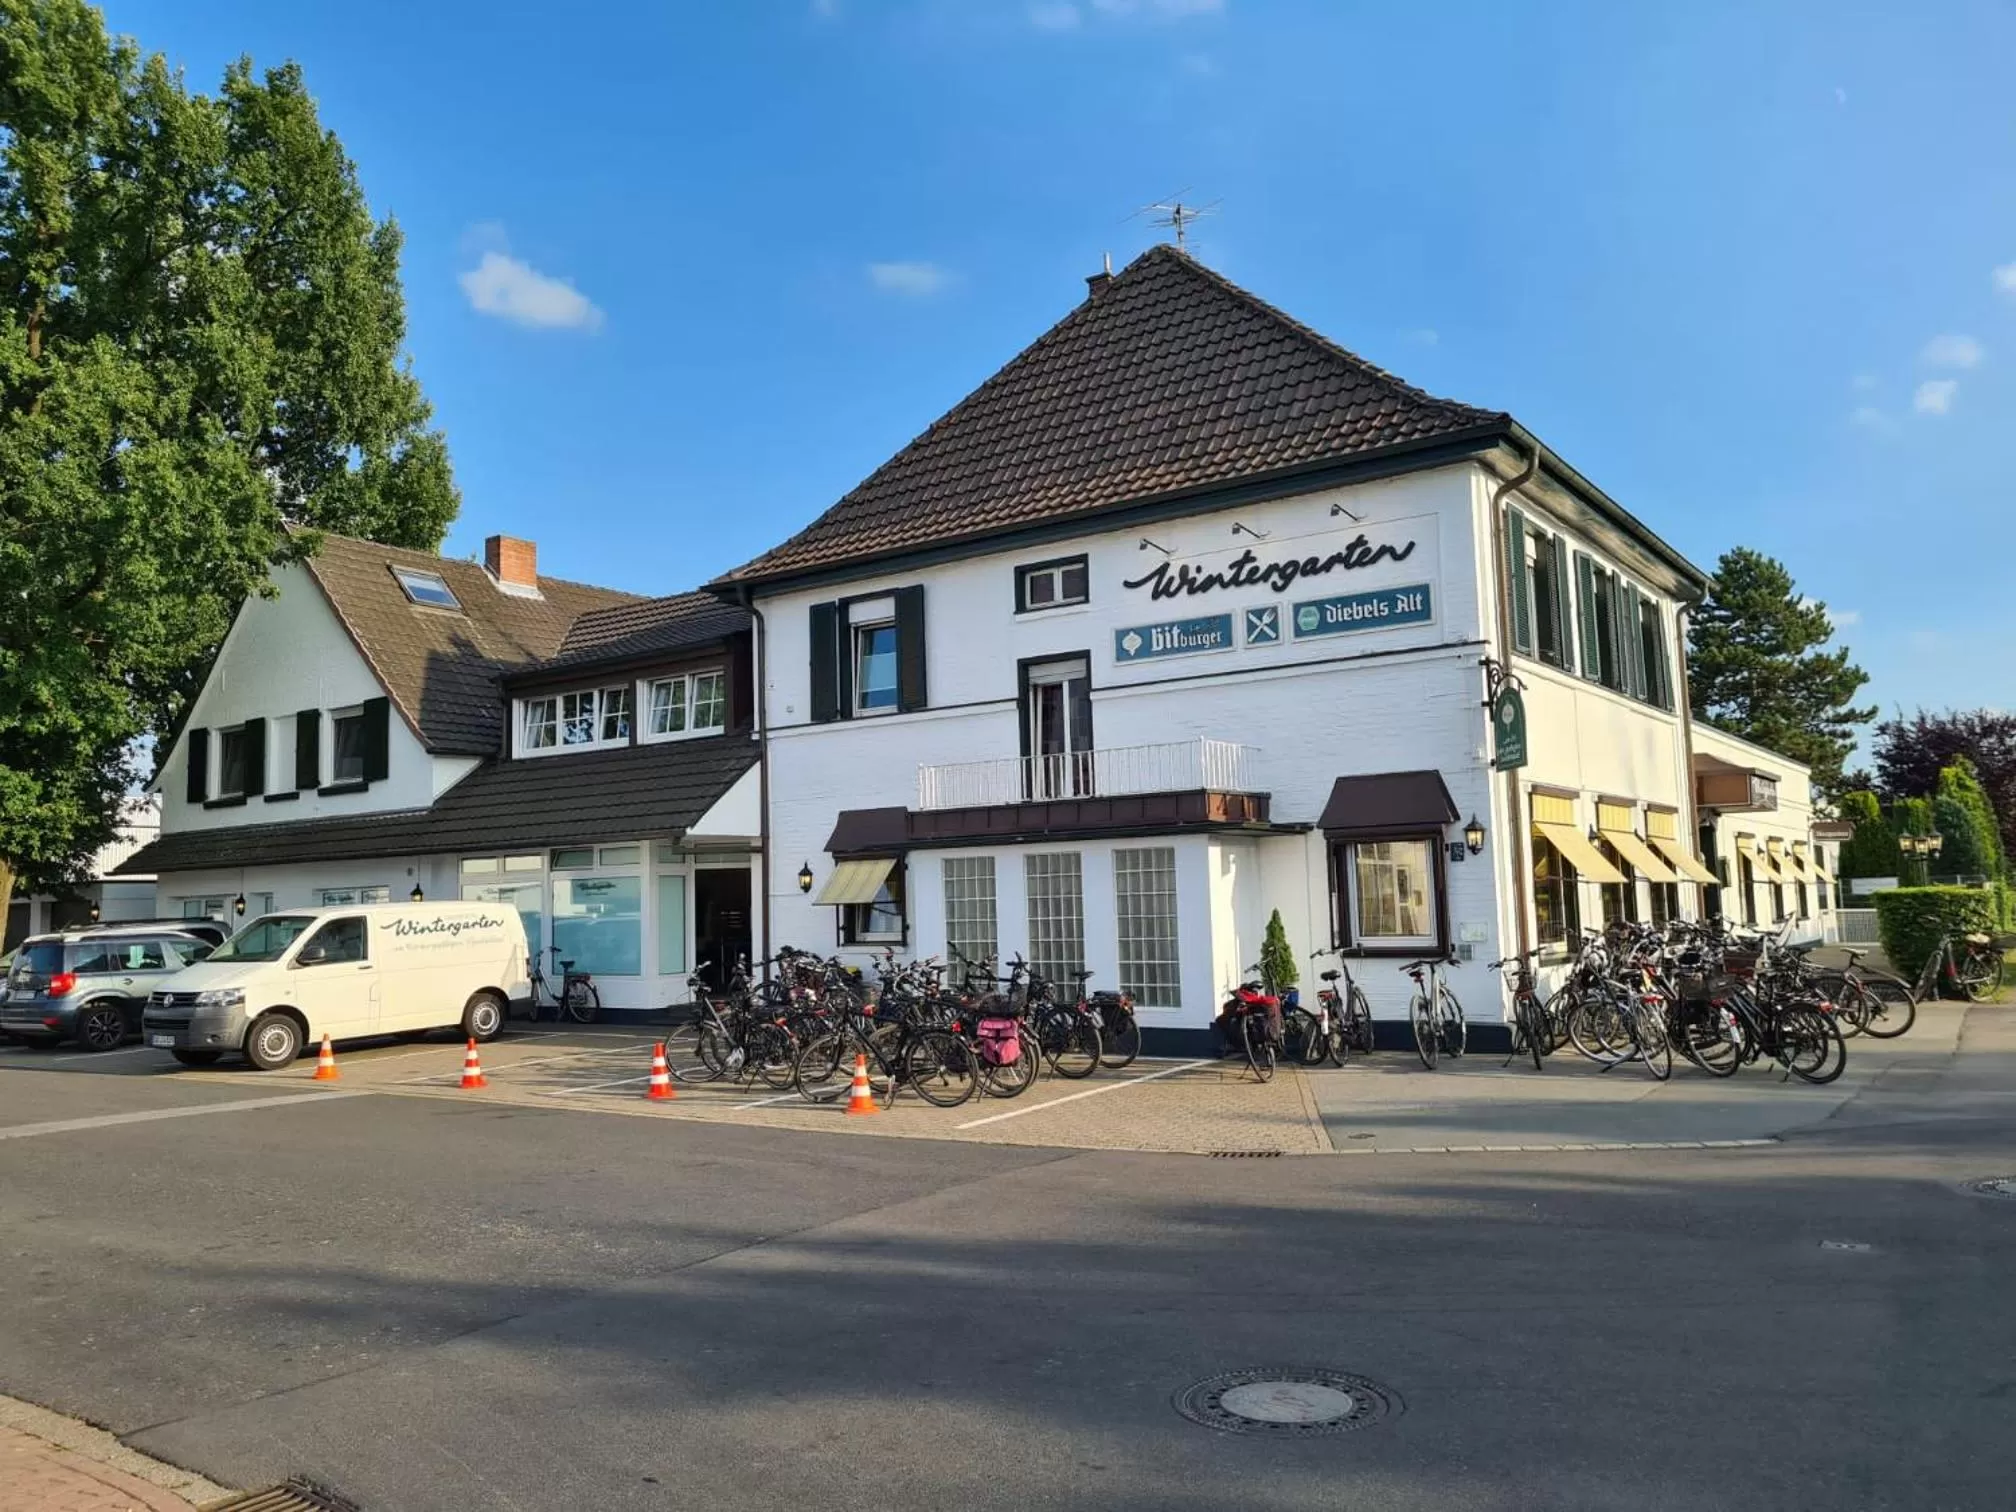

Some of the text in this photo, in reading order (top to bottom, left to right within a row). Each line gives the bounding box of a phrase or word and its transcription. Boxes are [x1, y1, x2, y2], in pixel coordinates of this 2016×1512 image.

[1123, 534, 1416, 601] Wintergarten
[1324, 592, 1423, 623] Diebels Alt
[380, 914, 505, 937] Wintergarten
